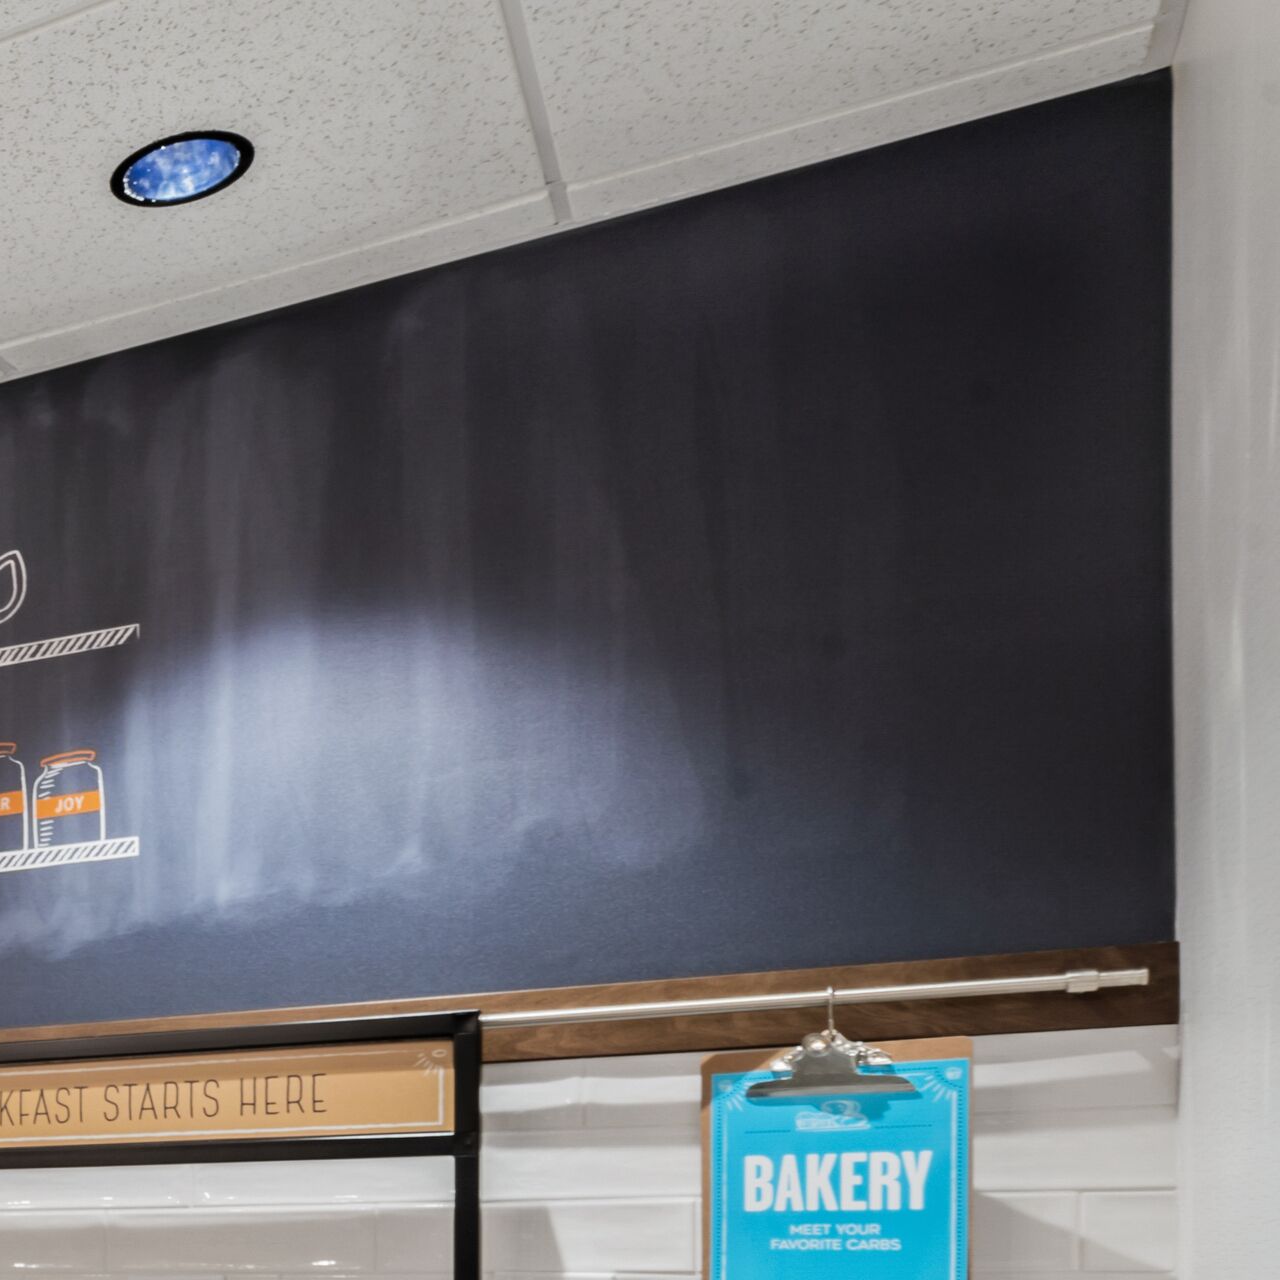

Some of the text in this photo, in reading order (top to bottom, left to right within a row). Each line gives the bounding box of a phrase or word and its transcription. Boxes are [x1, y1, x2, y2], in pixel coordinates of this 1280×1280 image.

[55, 796, 85, 813] JOY
[103, 1079, 220, 1122] STARTS
[240, 1073, 327, 1116] HERE
[743, 1150, 933, 1213] BAKERY
[790, 1223, 881, 1236] MEET YOUR
[770, 1238, 902, 1251] FAVORITE CARBS
